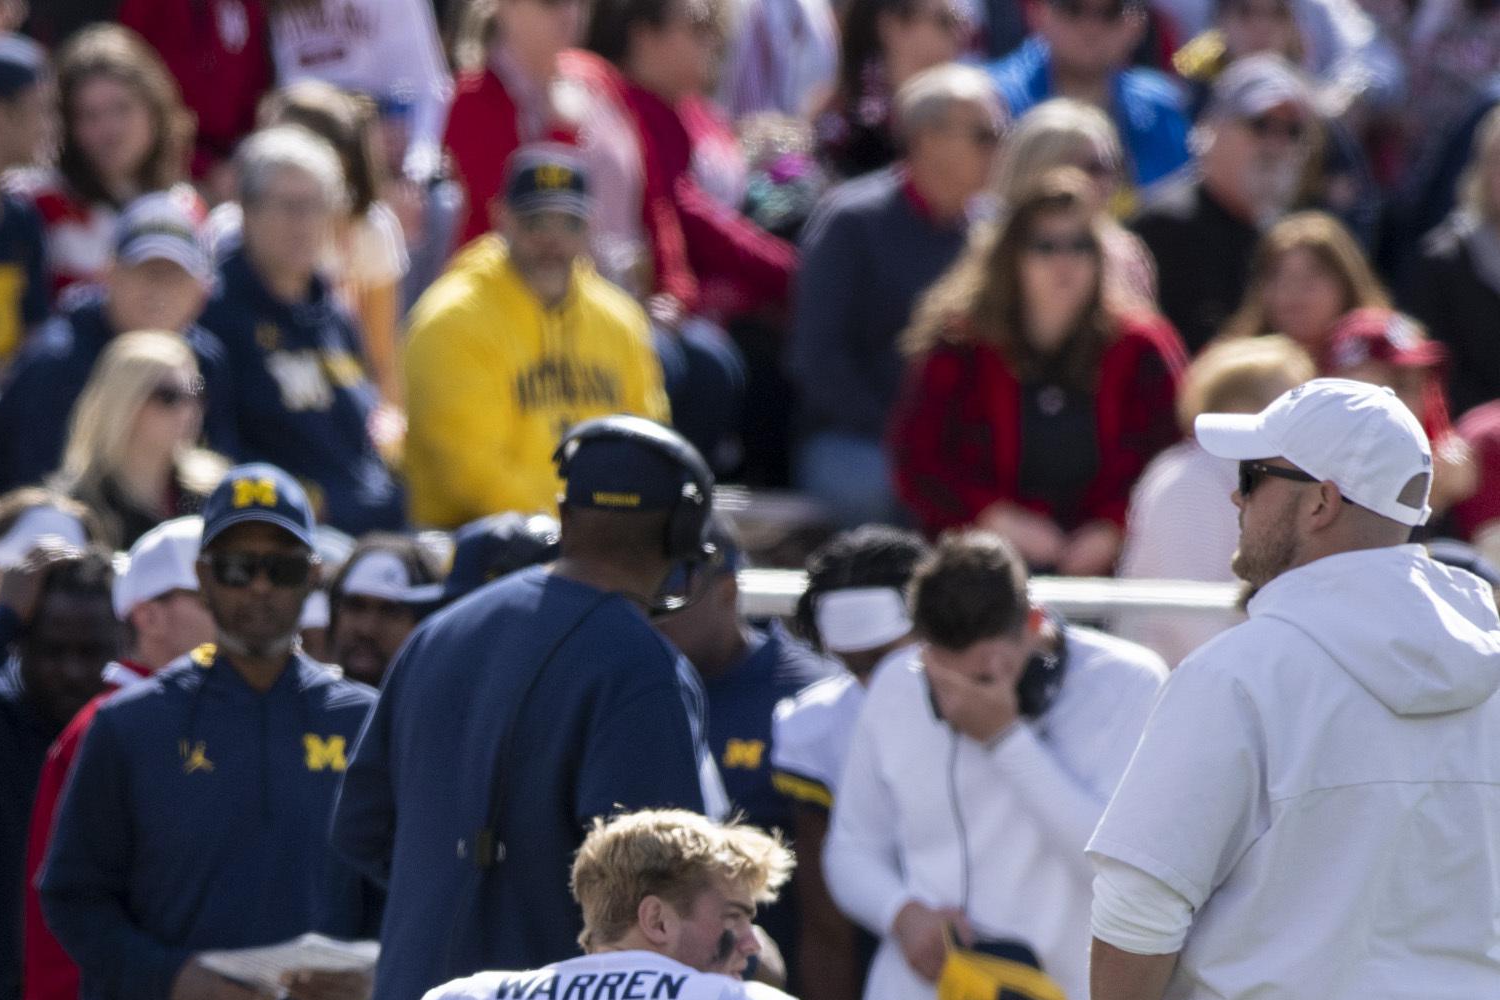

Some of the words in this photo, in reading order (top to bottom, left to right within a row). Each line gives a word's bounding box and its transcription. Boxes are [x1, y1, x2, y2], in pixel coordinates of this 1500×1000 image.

[232, 477, 277, 508] M
[303, 733, 347, 772] M
[723, 737, 766, 770] M
[496, 970, 689, 1000] WARREN
